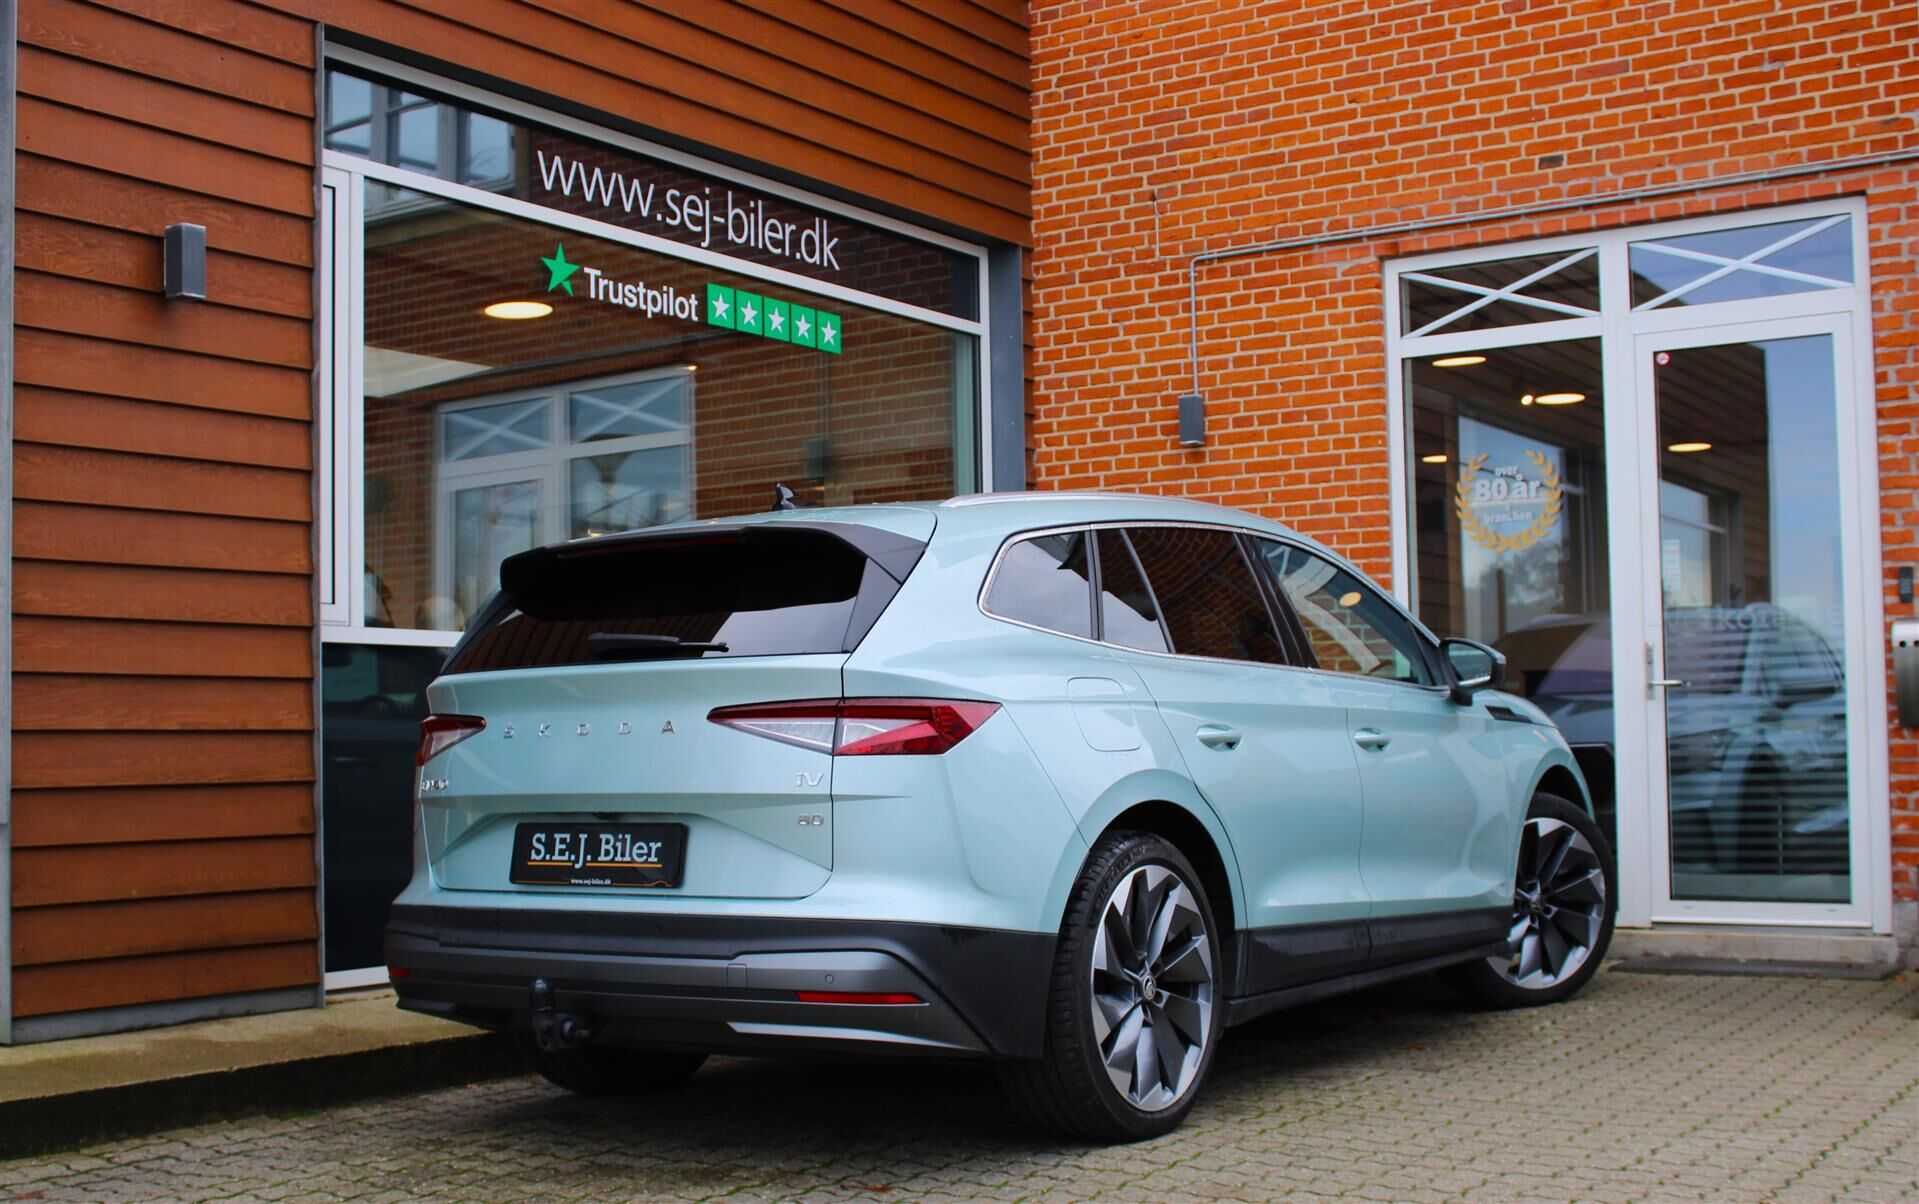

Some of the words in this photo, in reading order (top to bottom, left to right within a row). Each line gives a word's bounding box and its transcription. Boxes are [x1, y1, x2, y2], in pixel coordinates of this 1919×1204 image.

[537, 150, 841, 271] www.sej-biler.dk
[583, 267, 699, 321] Trustpilot
[1475, 478, 1508, 501] 80
[1512, 473, 1541, 499] år
[1495, 465, 1518, 477] over
[530, 832, 592, 869] S.E.J.
[597, 833, 663, 863] Biler
